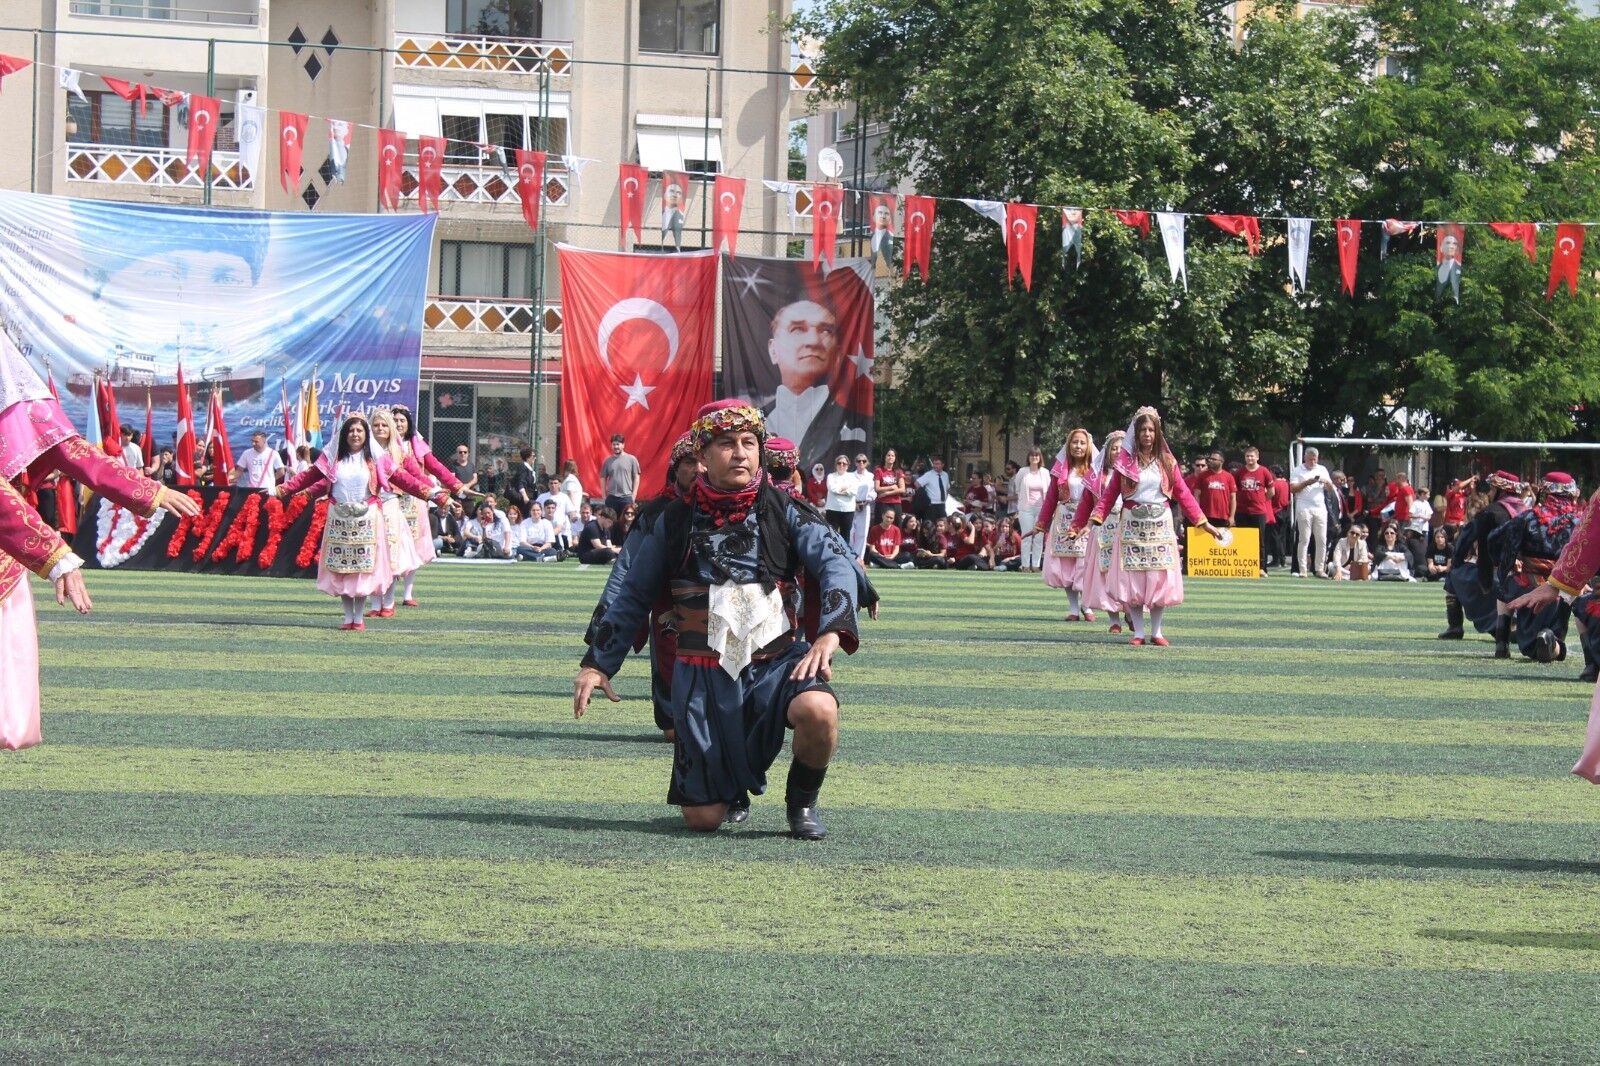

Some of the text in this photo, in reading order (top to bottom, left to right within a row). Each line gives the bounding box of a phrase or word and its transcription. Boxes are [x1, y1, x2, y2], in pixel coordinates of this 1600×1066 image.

[330, 372, 402, 400] Mayıs
[240, 415, 285, 429] Gençlik
[166, 488, 322, 569] MAYI
[1208, 548, 1238, 557] SELÇUK
[1188, 558, 1259, 568] ŞEHİT EROL OLÇOK
[1193, 568, 1254, 577] ANADOLU LİSESİ
